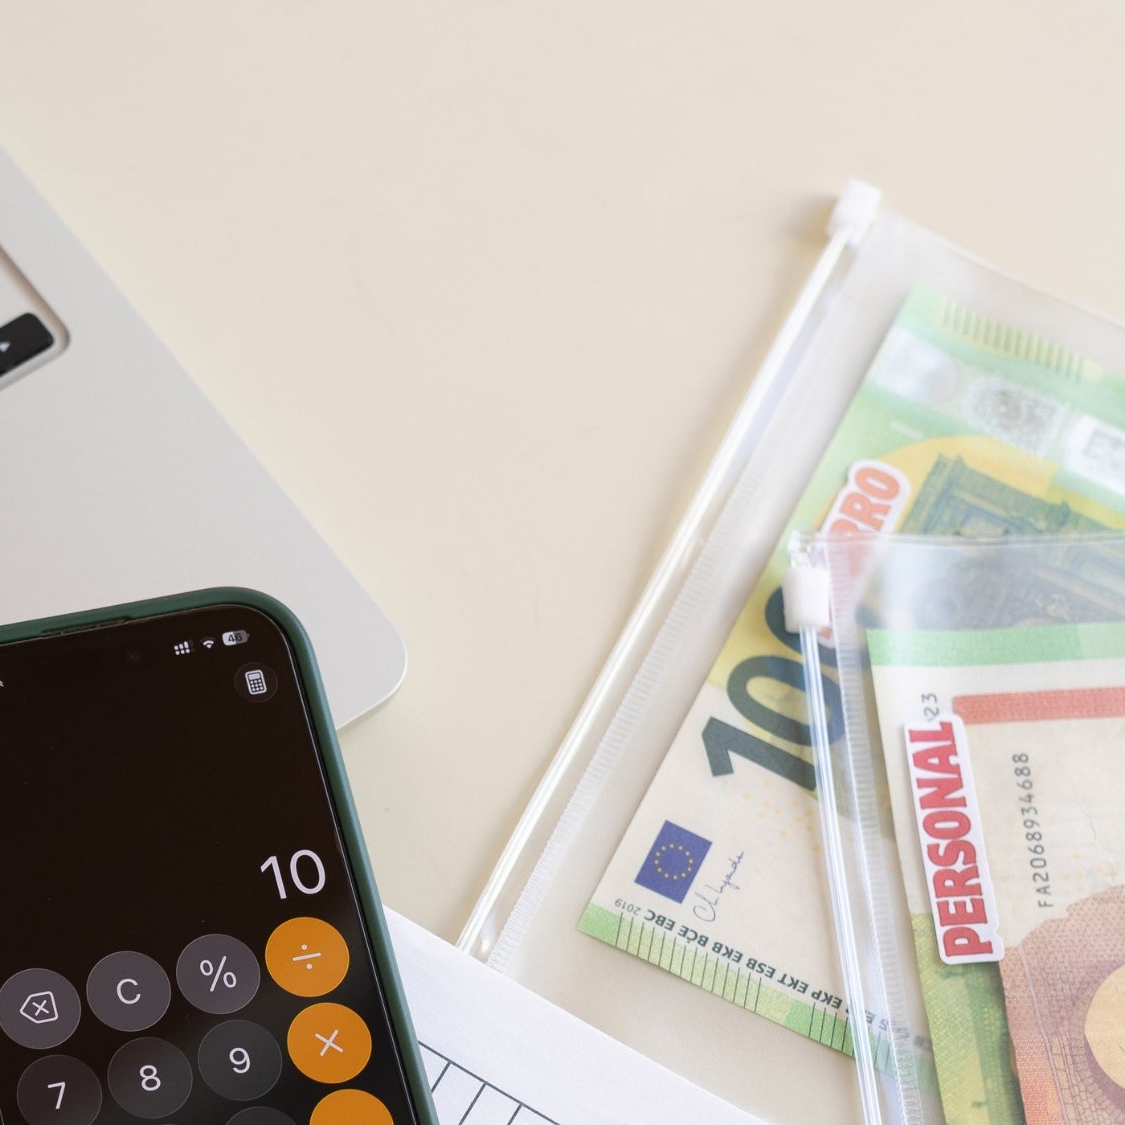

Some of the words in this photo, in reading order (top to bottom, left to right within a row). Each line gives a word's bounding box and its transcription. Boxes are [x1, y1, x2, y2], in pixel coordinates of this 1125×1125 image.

[921, 691, 940, 722] 23
[908, 720, 994, 958] PERSONAL
[1011, 751, 1054, 909] FA2068934688
[260, 849, 326, 900] 10
[614, 897, 641, 917] 2019
[643, 908, 675, 932] EBC
[711, 940, 743, 964] EKB
[746, 957, 776, 979] ESB
[116, 978, 141, 1005] C
[777, 972, 809, 995] EKT
[811, 989, 843, 1010] EKP
[229, 1047, 251, 1074] 9
[139, 1064, 162, 1092] 8
[47, 1081, 66, 1110] 7
